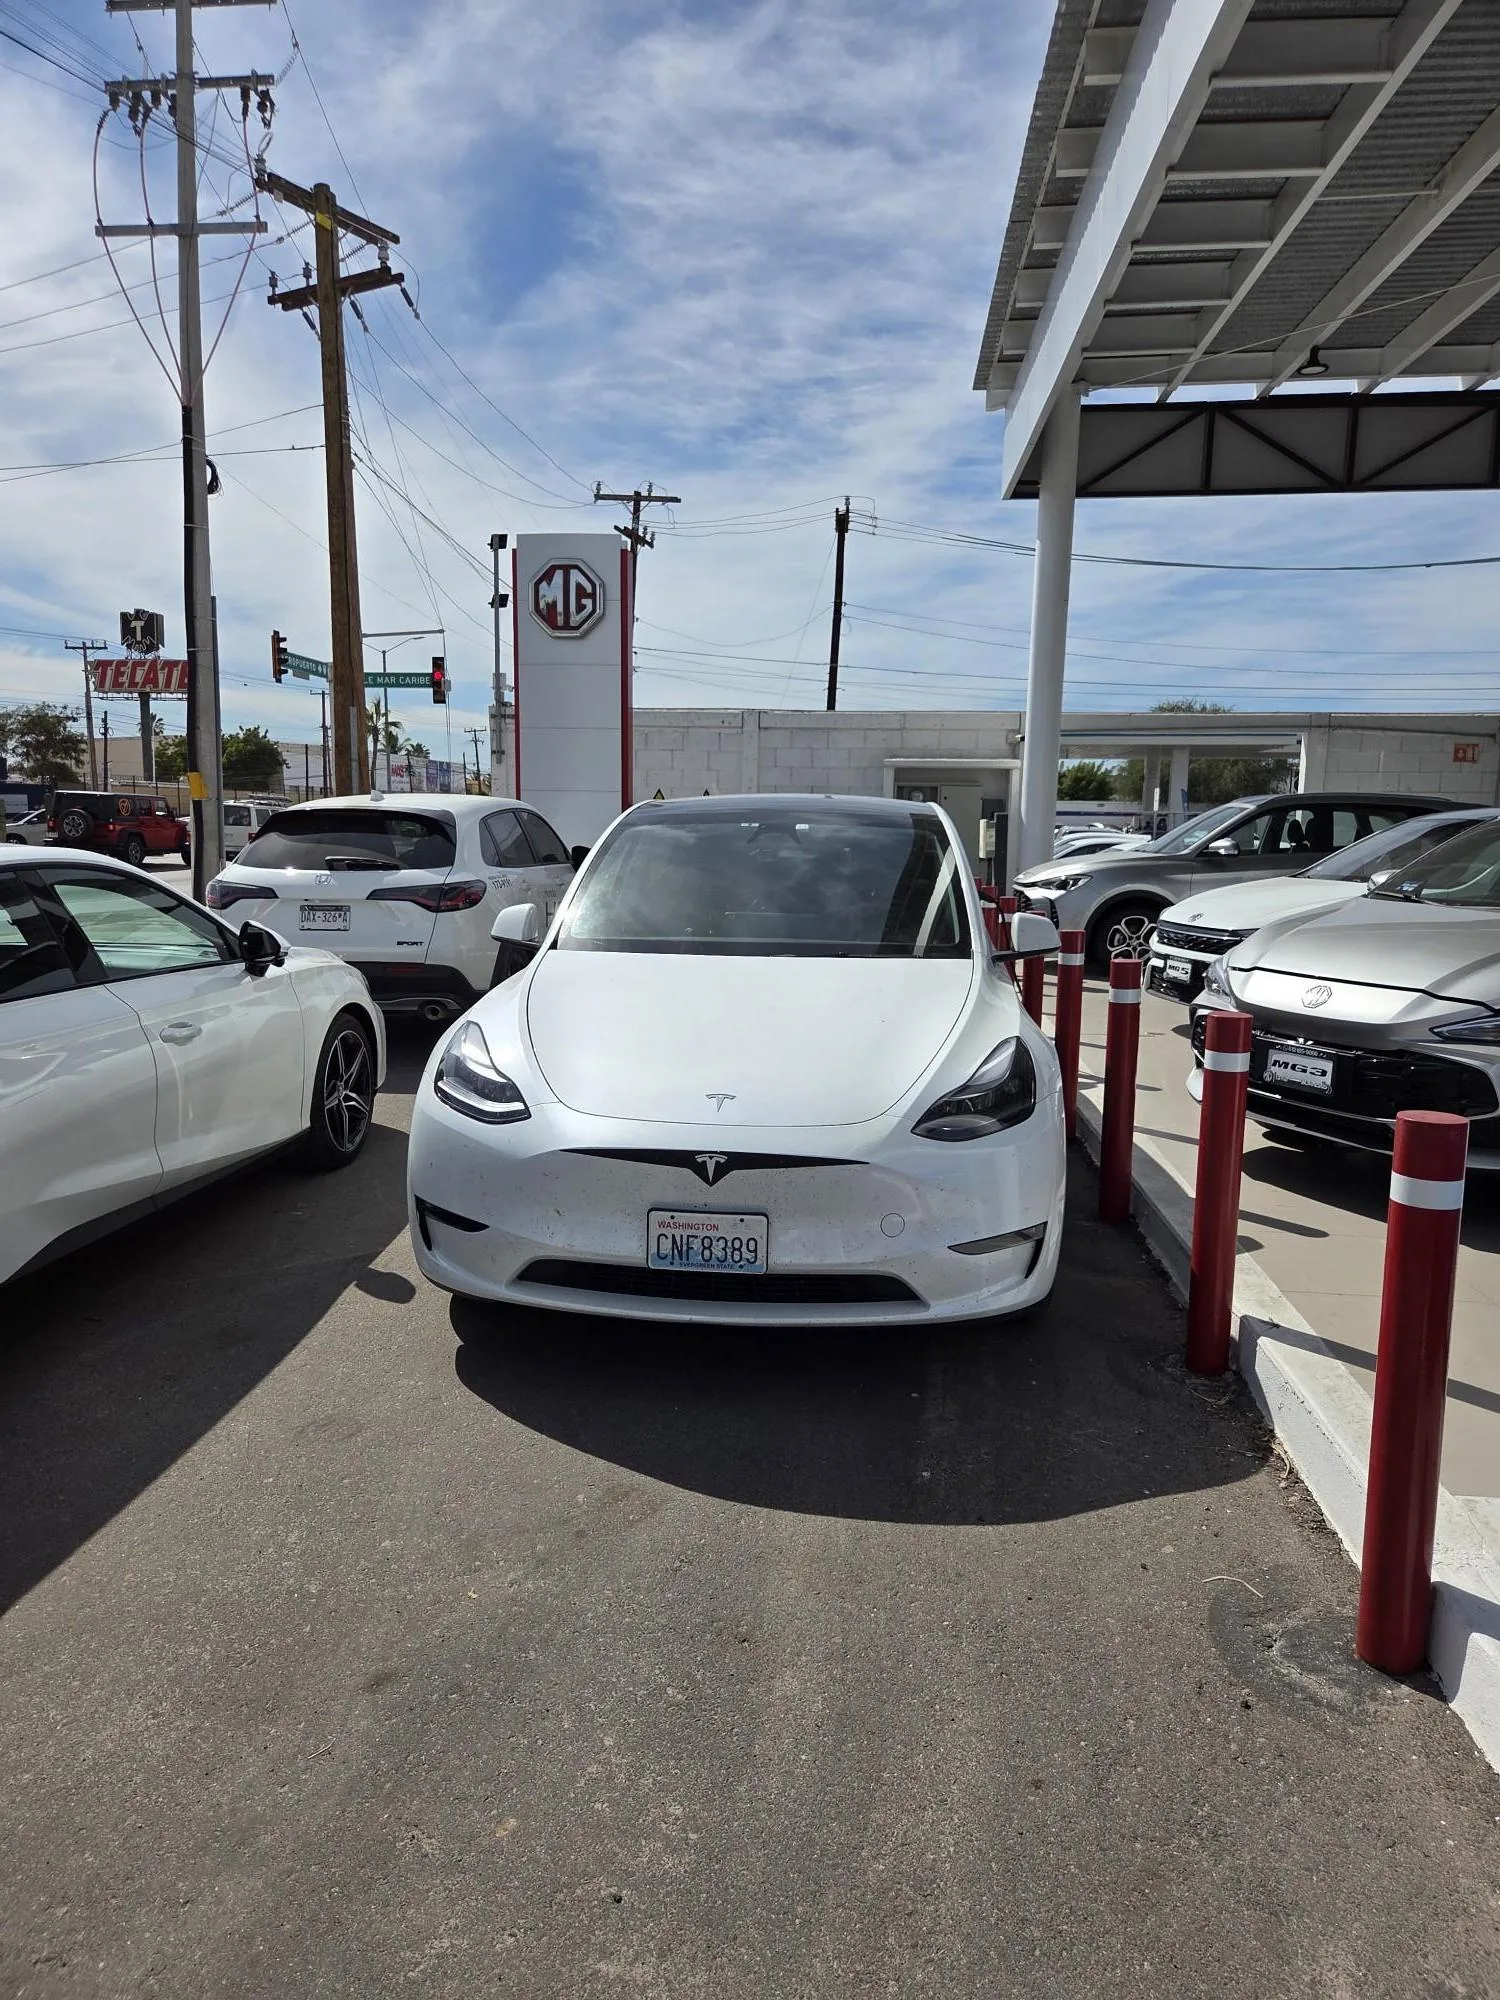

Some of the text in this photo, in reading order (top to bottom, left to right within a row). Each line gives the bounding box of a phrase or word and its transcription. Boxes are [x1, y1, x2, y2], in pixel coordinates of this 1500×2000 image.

[539, 569, 593, 627] MG
[377, 676, 397, 685] MAR
[399, 676, 431, 685] CARIBE
[1271, 1059, 1328, 1077] MG3
[657, 1220, 719, 1232] WASHINGTON
[656, 1233, 759, 1264] CNF8389
